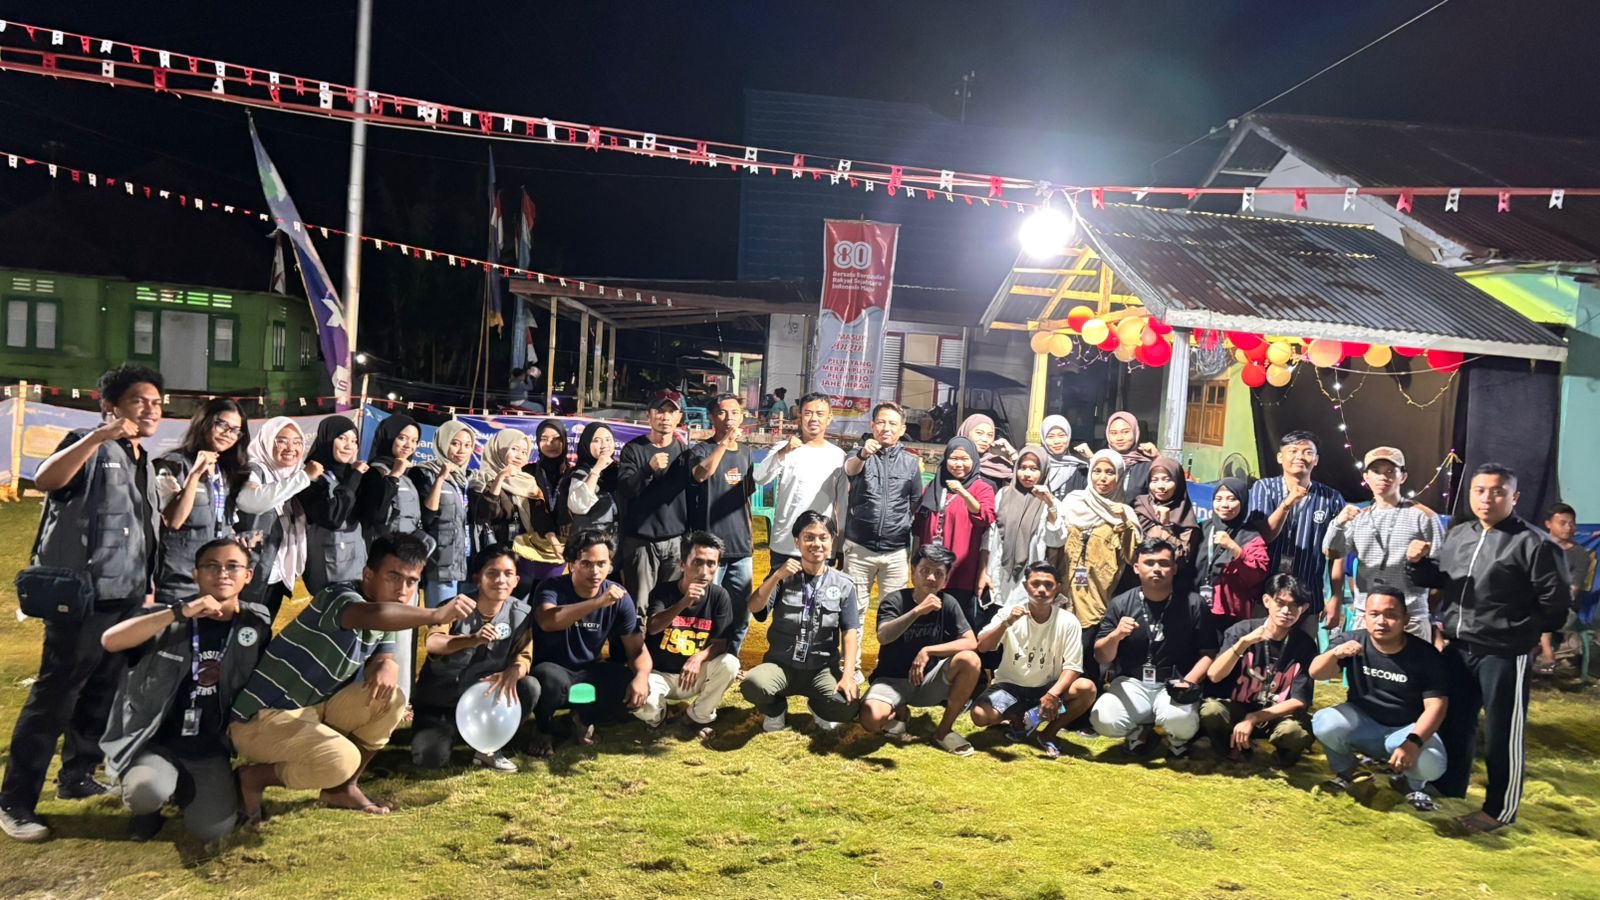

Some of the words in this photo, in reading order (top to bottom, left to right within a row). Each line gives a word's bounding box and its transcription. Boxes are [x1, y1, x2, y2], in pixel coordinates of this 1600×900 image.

[833, 240, 872, 270] 80
[850, 359, 872, 367] YANG
[852, 367, 875, 375] PUTIH
